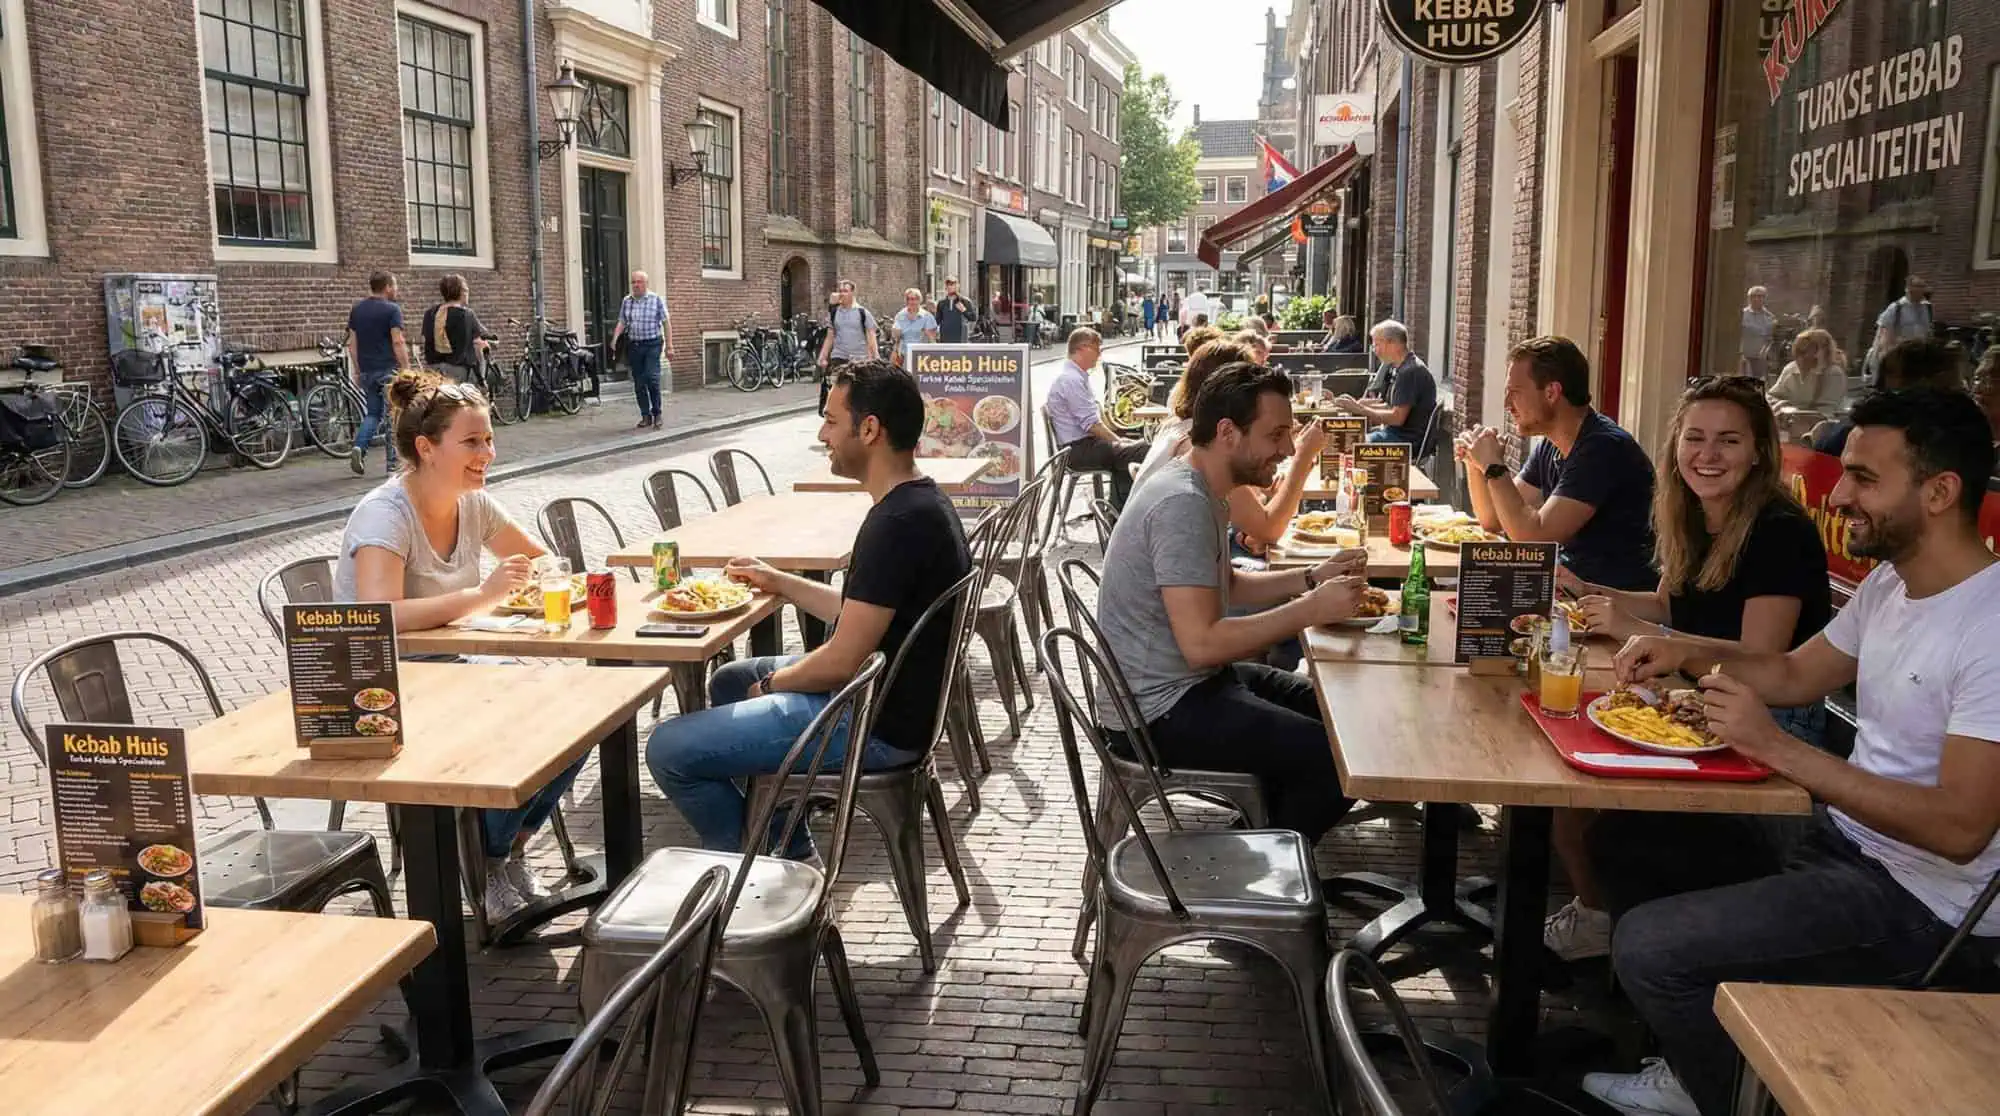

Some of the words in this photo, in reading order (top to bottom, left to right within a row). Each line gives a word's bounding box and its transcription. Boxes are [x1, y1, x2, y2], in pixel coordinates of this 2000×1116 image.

[1414, 0, 1516, 20] KEBAB
[1427, 22, 1501, 48] HUIS
[1797, 65, 1875, 134] TURKSE
[1878, 34, 1964, 110] KEBAB
[1788, 112, 1964, 197] SPECIALITEITEN
[916, 355, 973, 373] Kebab
[978, 355, 1018, 373] Huis
[1472, 547, 1512, 561] Kebab
[1516, 547, 1545, 561] Huis
[295, 609, 343, 626] Kebab
[346, 609, 382, 625] Huis
[63, 733, 121, 755] Kebab
[126, 735, 169, 757] Huis
